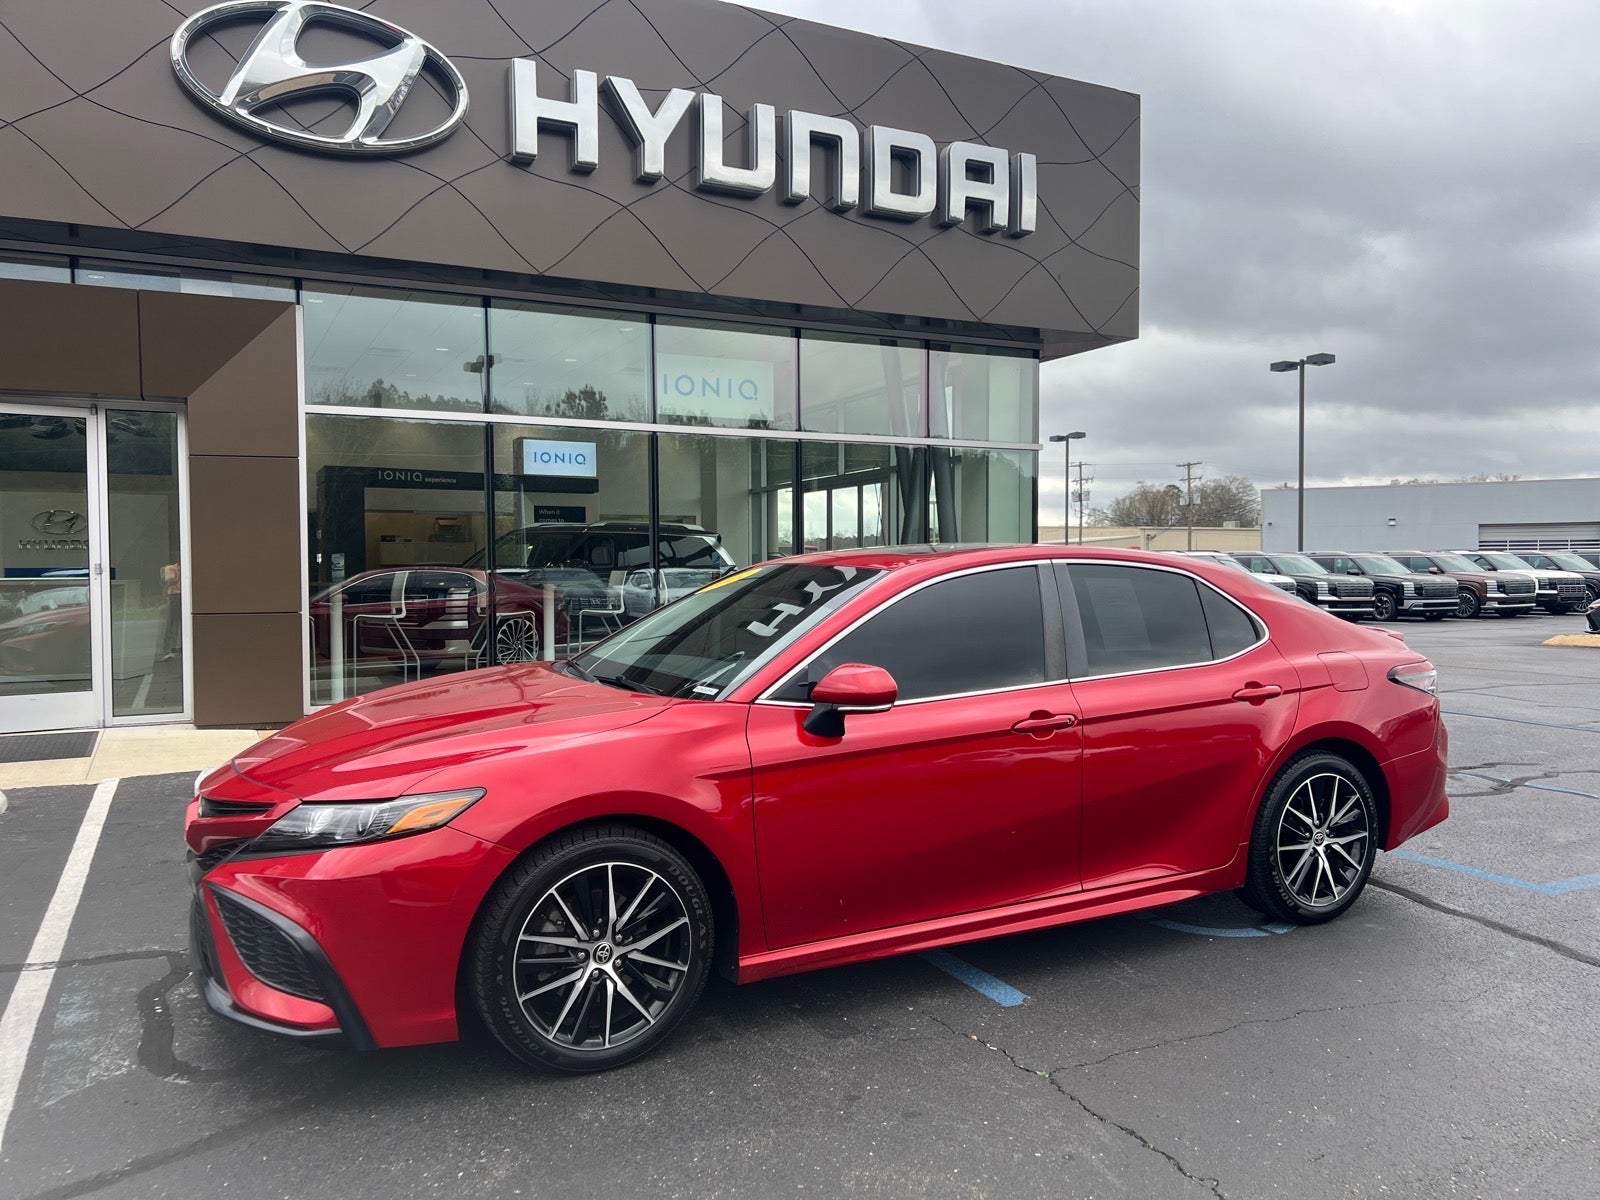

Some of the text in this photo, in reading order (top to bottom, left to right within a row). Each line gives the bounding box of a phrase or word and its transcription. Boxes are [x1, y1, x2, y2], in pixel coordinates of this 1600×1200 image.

[508, 57, 1038, 237] HYUNDAI
[663, 373, 758, 401] IONIQ
[533, 451, 586, 465] IONIQ
[378, 470, 423, 482] IONIQ
[667, 865, 706, 950] DOUGLAS
